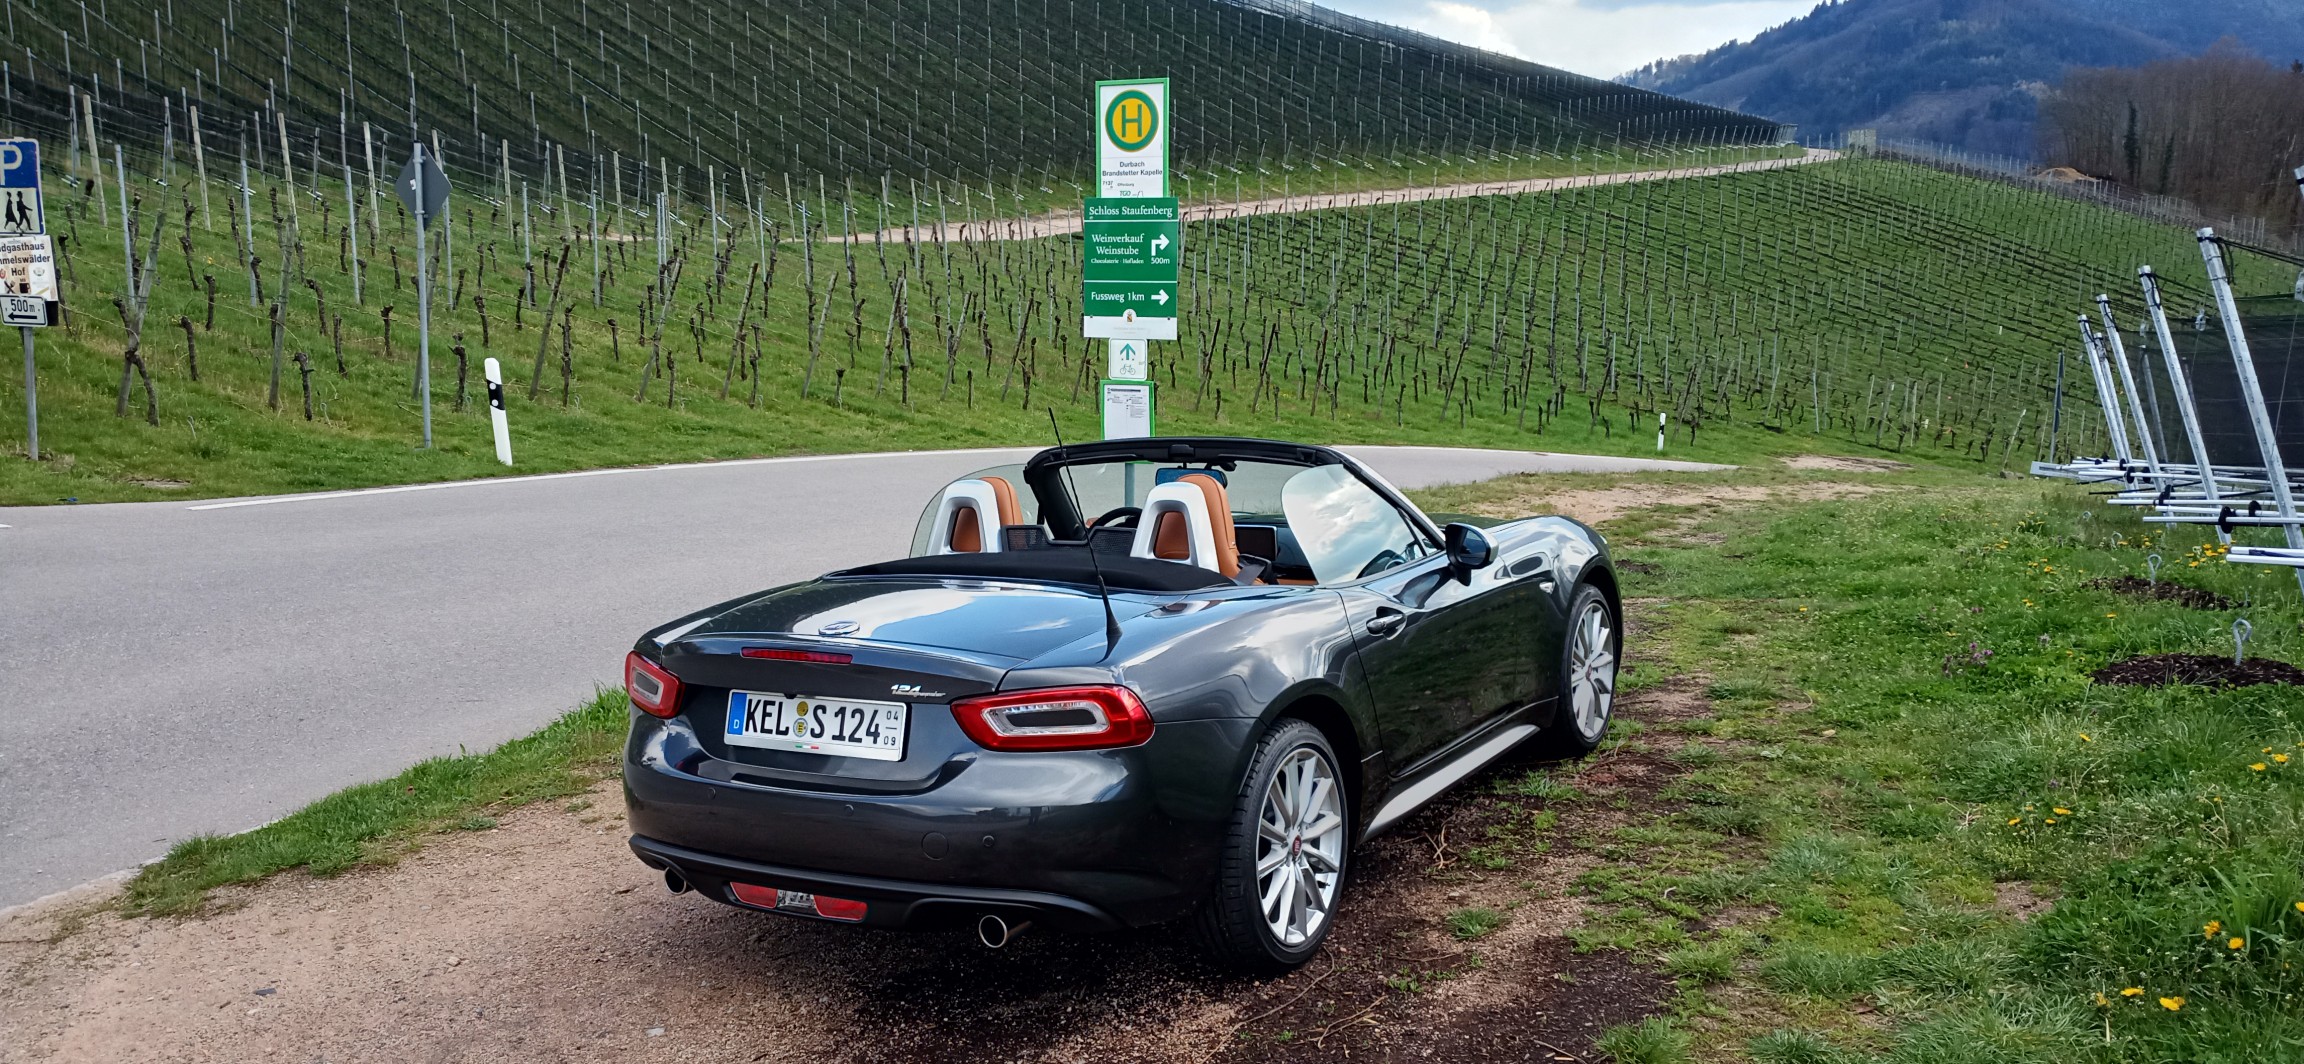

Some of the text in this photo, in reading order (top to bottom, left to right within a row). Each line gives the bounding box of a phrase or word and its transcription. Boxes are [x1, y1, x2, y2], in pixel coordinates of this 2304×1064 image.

[1121, 104, 1143, 138] H
[0, 144, 23, 186] P
[1089, 204, 1173, 218] Schloss Staufenberg
[1091, 233, 1145, 243] Weinverkauf
[0, 242, 45, 254] dgasthaus
[1096, 245, 1139, 255] Weinstube
[11, 266, 26, 276] Hof
[1091, 291, 1125, 303] Fussweg
[744, 698, 881, 745] KEL S 124
[886, 710, 899, 722] 04
[733, 719, 740, 729] D
[883, 735, 896, 746] 09
